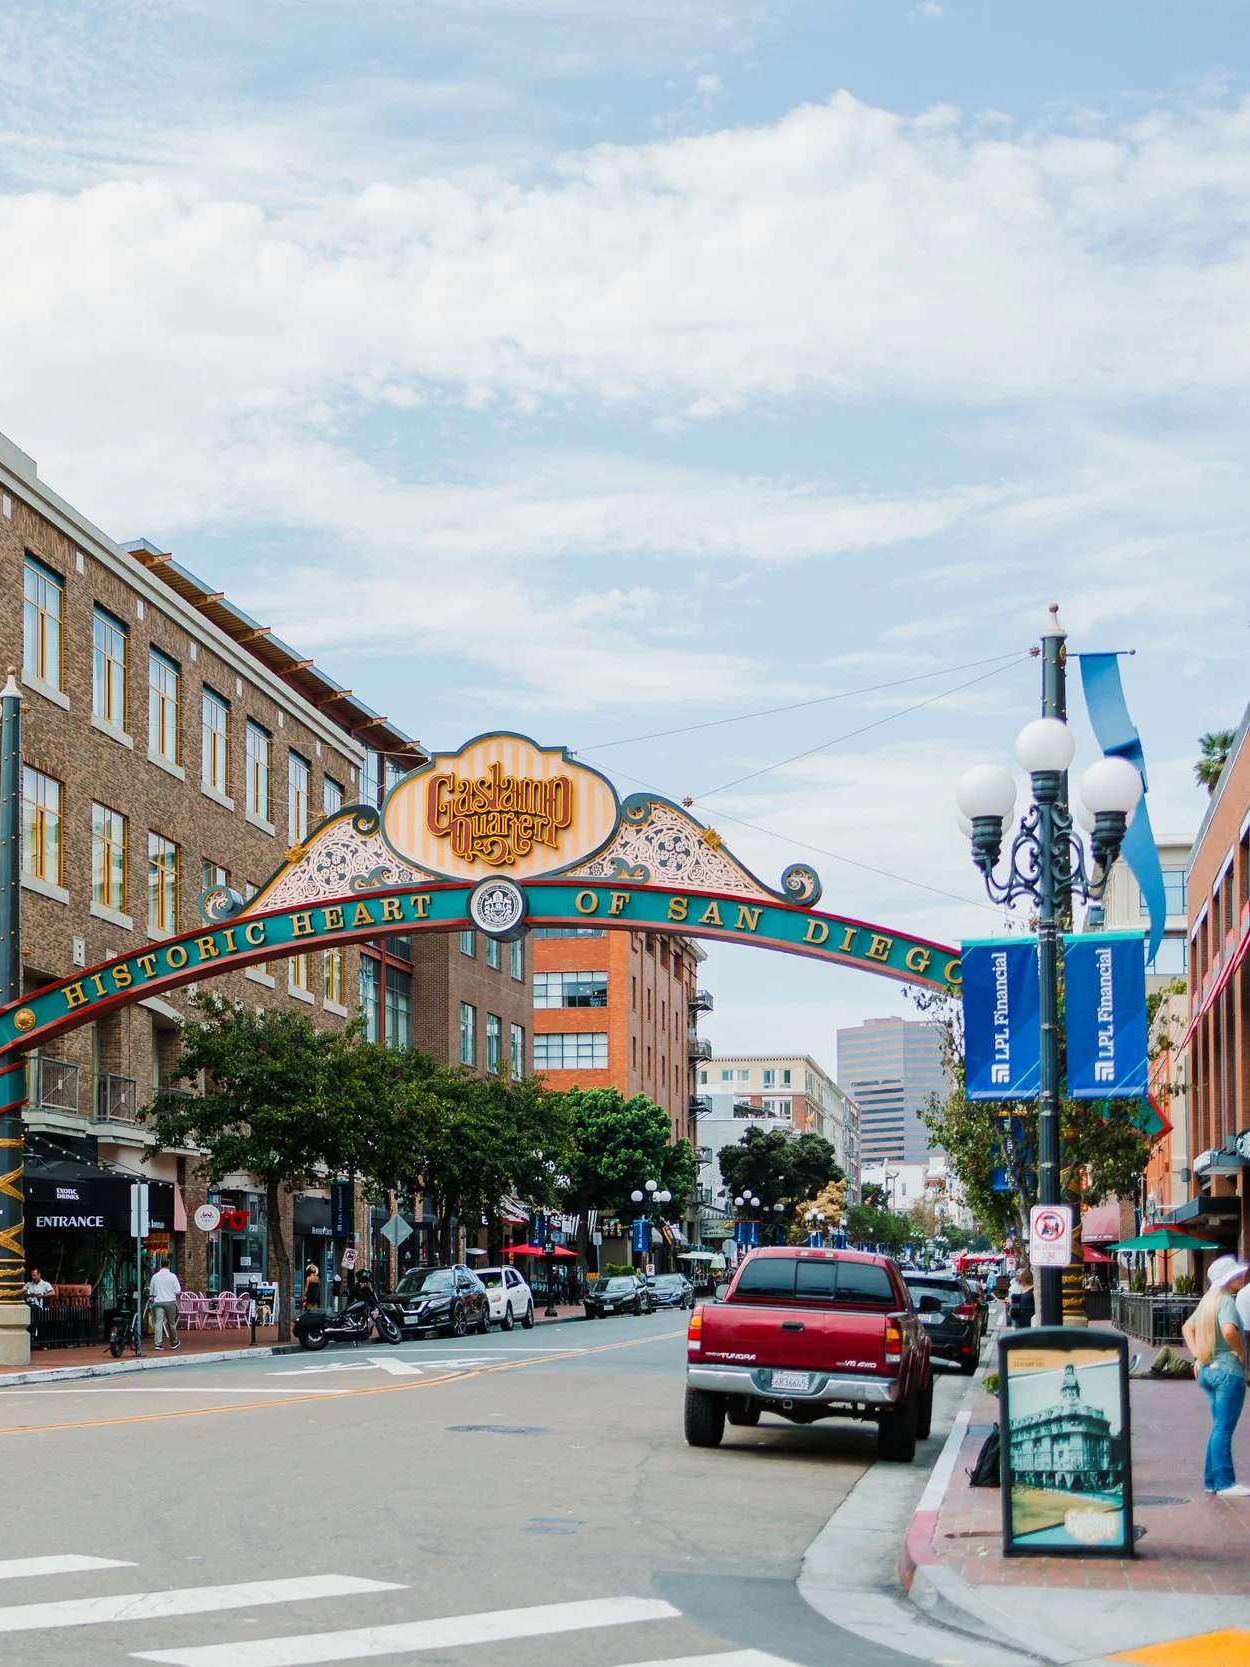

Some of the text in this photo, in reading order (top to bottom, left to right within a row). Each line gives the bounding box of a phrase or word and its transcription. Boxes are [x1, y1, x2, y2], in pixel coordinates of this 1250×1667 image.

[426, 760, 572, 849] Gaslamp
[451, 812, 548, 865] Quarter
[61, 922, 266, 1009] HISTORIC
[289, 895, 431, 937] HEART
[575, 890, 630, 915] OF
[667, 896, 764, 931] SAN
[991, 951, 1010, 1061] LPL Financial
[1095, 945, 1114, 1058] LPL Financial
[36, 1216, 104, 1228] ENTRANCE
[56, 1187, 78, 1195] EXOTIC
[721, 1352, 756, 1360] TUNDRA
